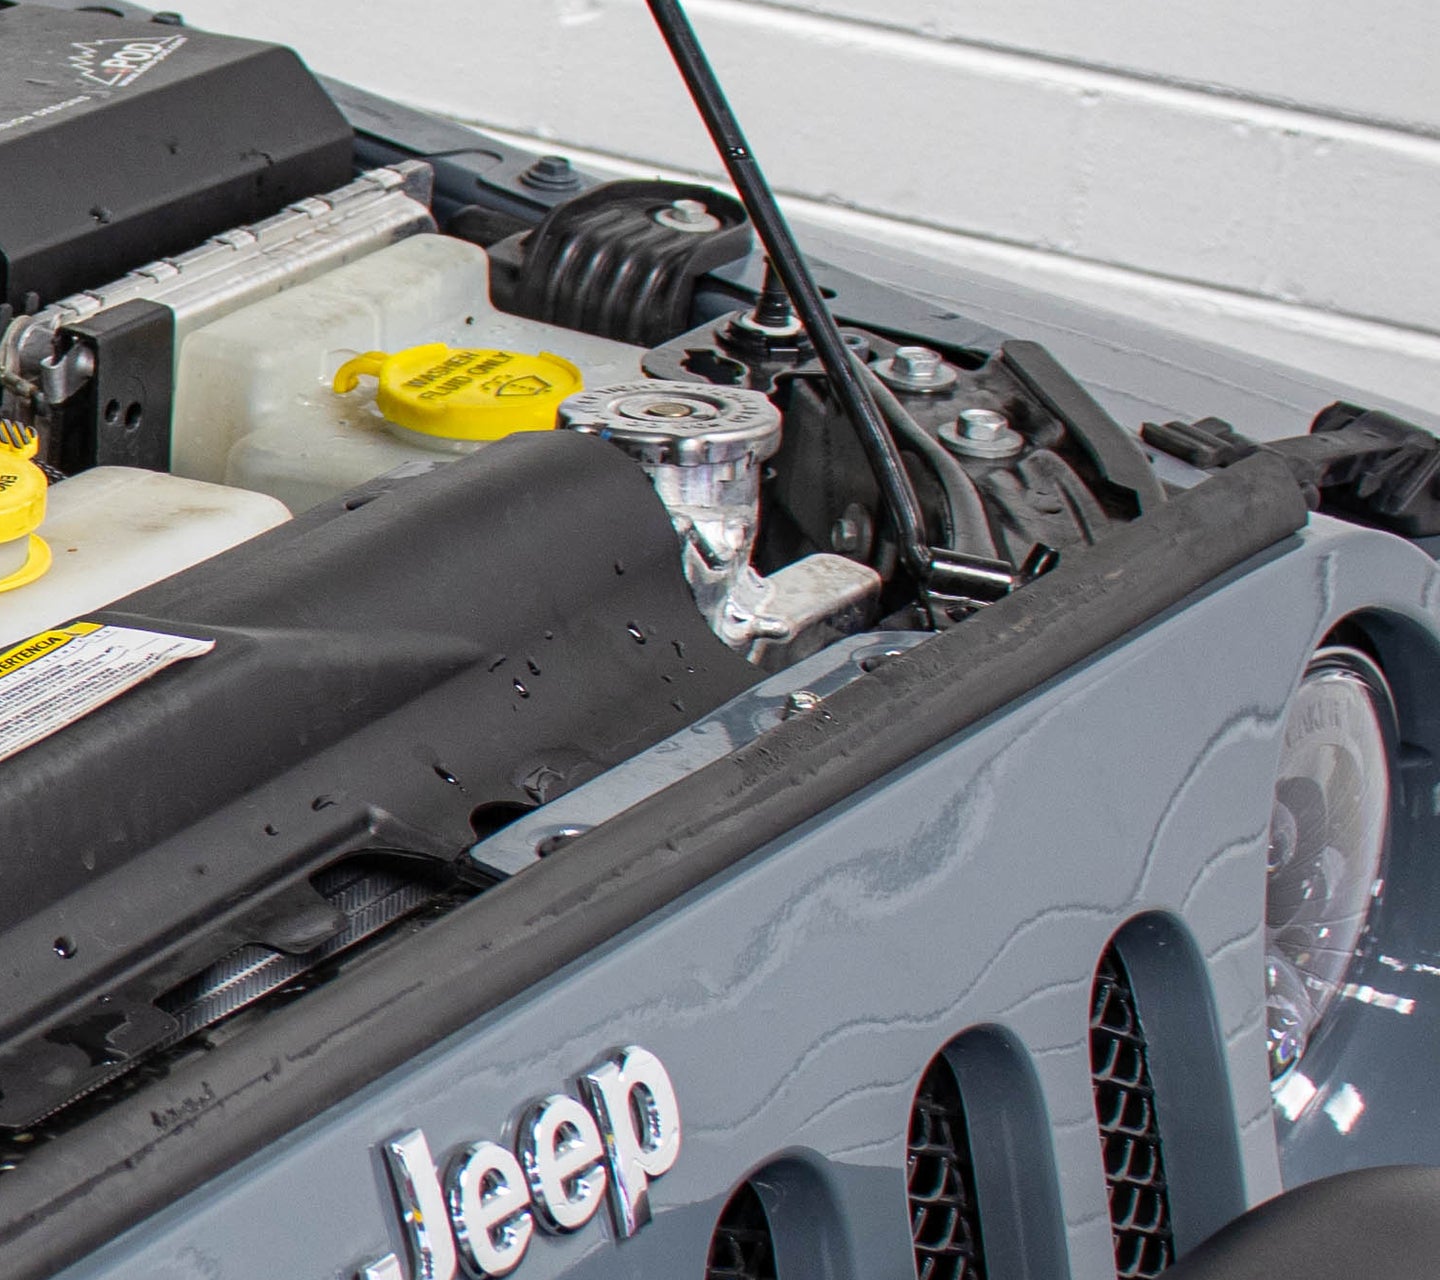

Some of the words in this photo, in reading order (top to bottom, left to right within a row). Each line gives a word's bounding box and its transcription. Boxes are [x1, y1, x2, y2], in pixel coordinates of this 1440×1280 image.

[403, 351, 482, 389] WASHER
[419, 375, 473, 401] FLUID
[467, 351, 515, 382] ONLY
